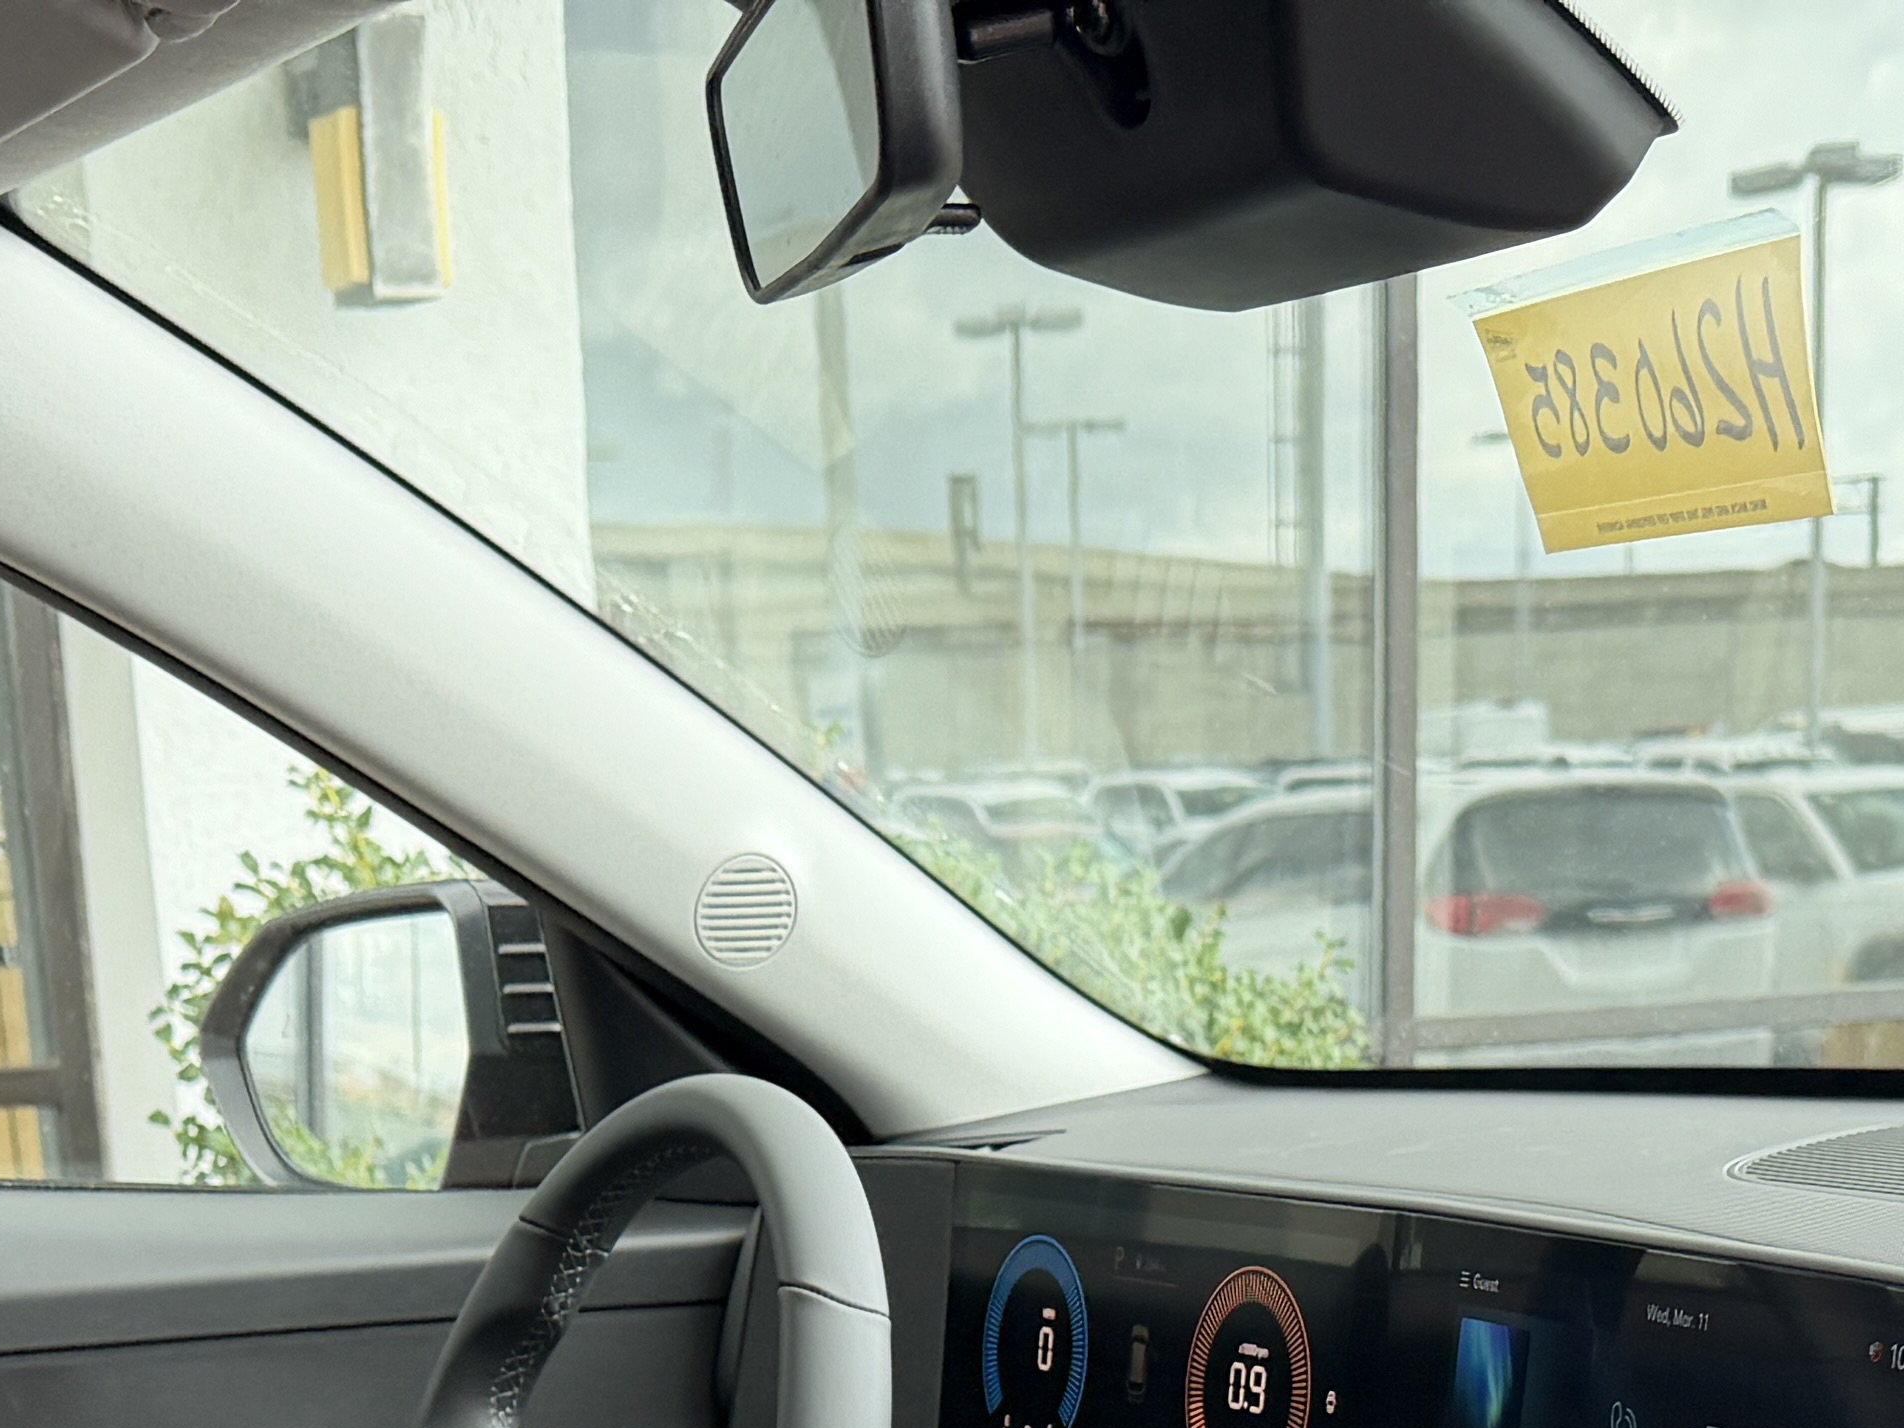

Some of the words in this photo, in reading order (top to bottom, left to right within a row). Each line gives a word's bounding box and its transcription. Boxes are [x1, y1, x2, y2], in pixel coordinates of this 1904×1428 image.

[1646, 1303, 1671, 1328] Wed,
[1673, 1308, 1696, 1329] Mar.
[1698, 1312, 1711, 1332] 11
[1037, 1325, 1056, 1372] 0
[1227, 1360, 1269, 1415] 0.9
